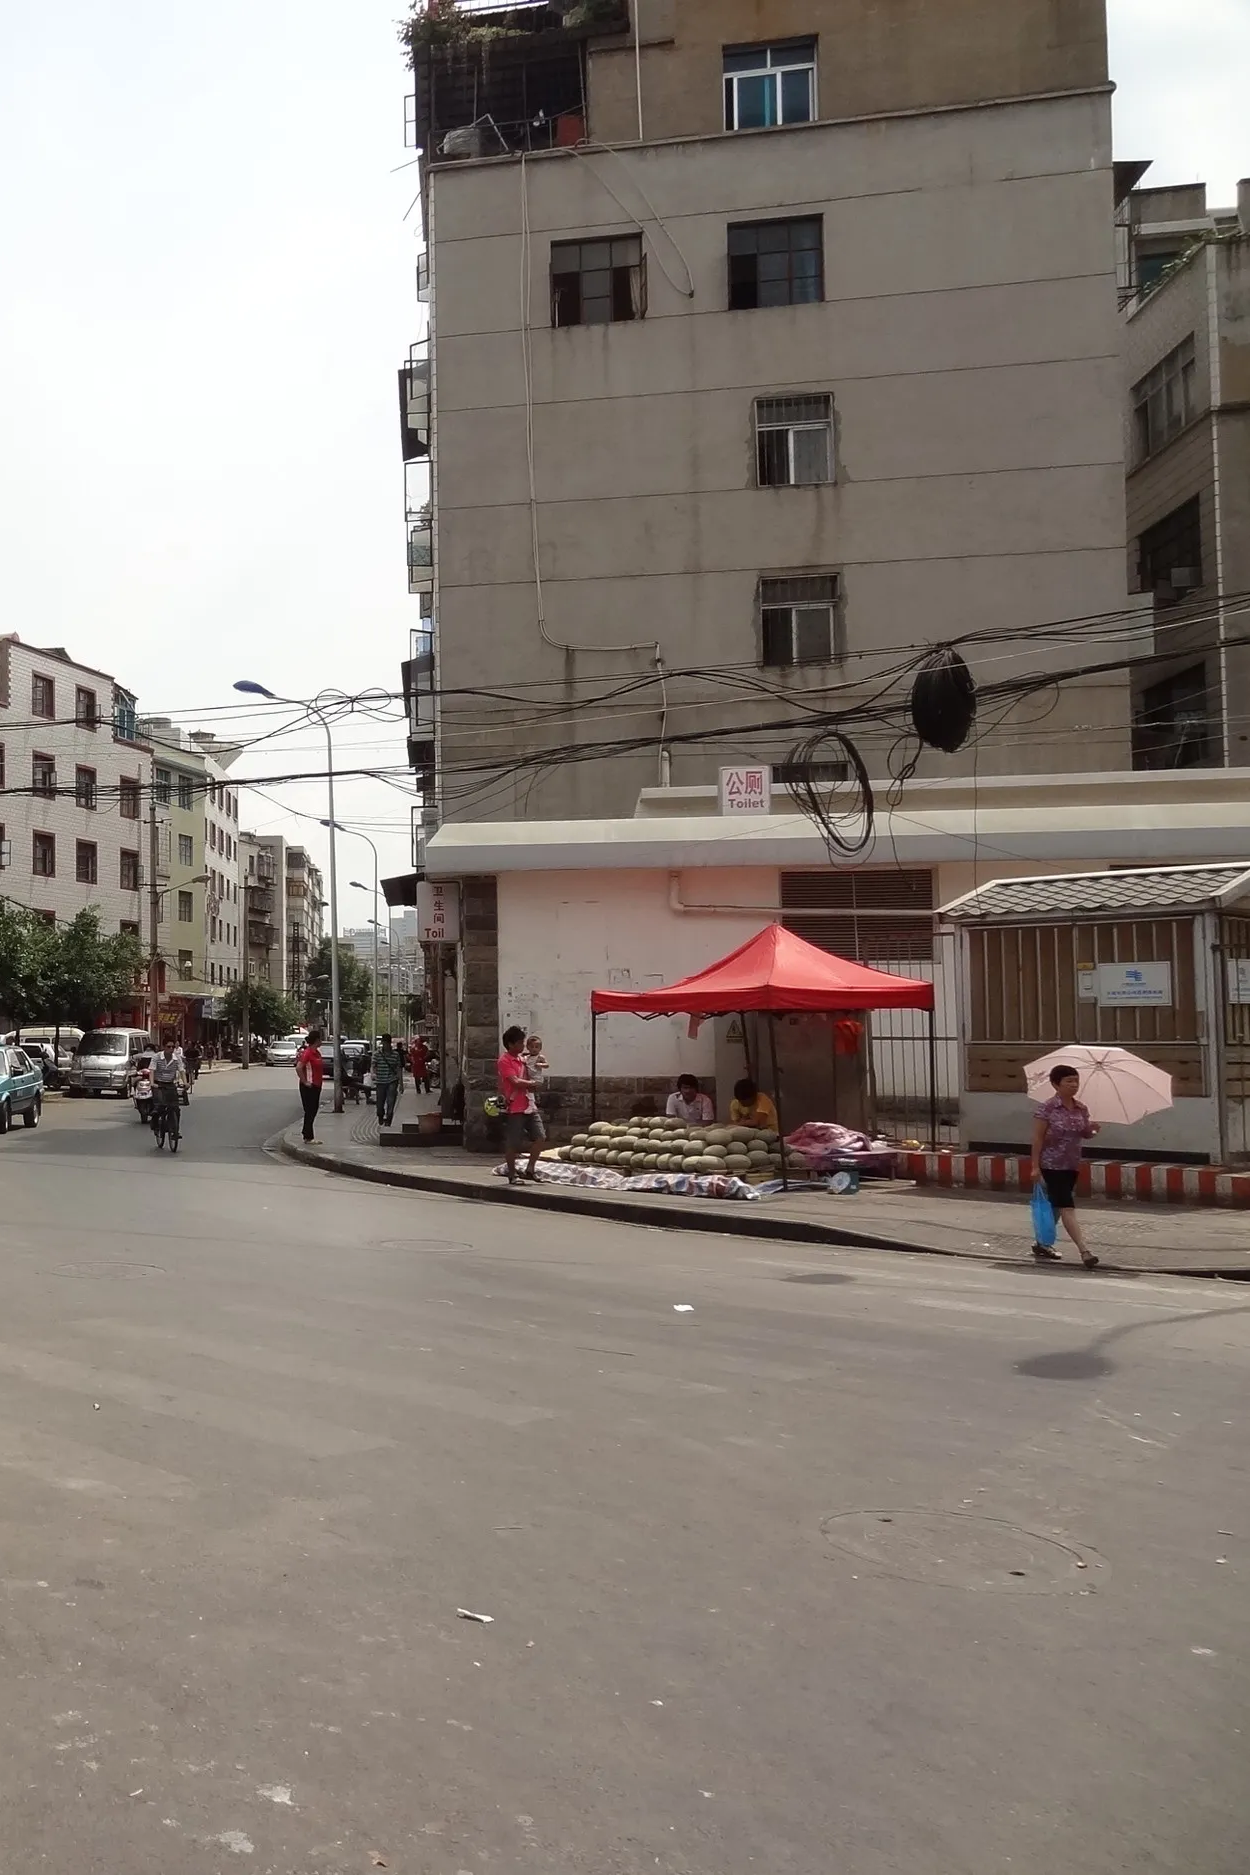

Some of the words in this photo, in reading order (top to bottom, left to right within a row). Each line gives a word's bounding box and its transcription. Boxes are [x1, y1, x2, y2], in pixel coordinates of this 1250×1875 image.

[726, 771, 762, 795] 公厕
[728, 798, 764, 808] Toilet
[433, 886, 445, 924] 卫生间
[425, 928, 444, 938] Toil
